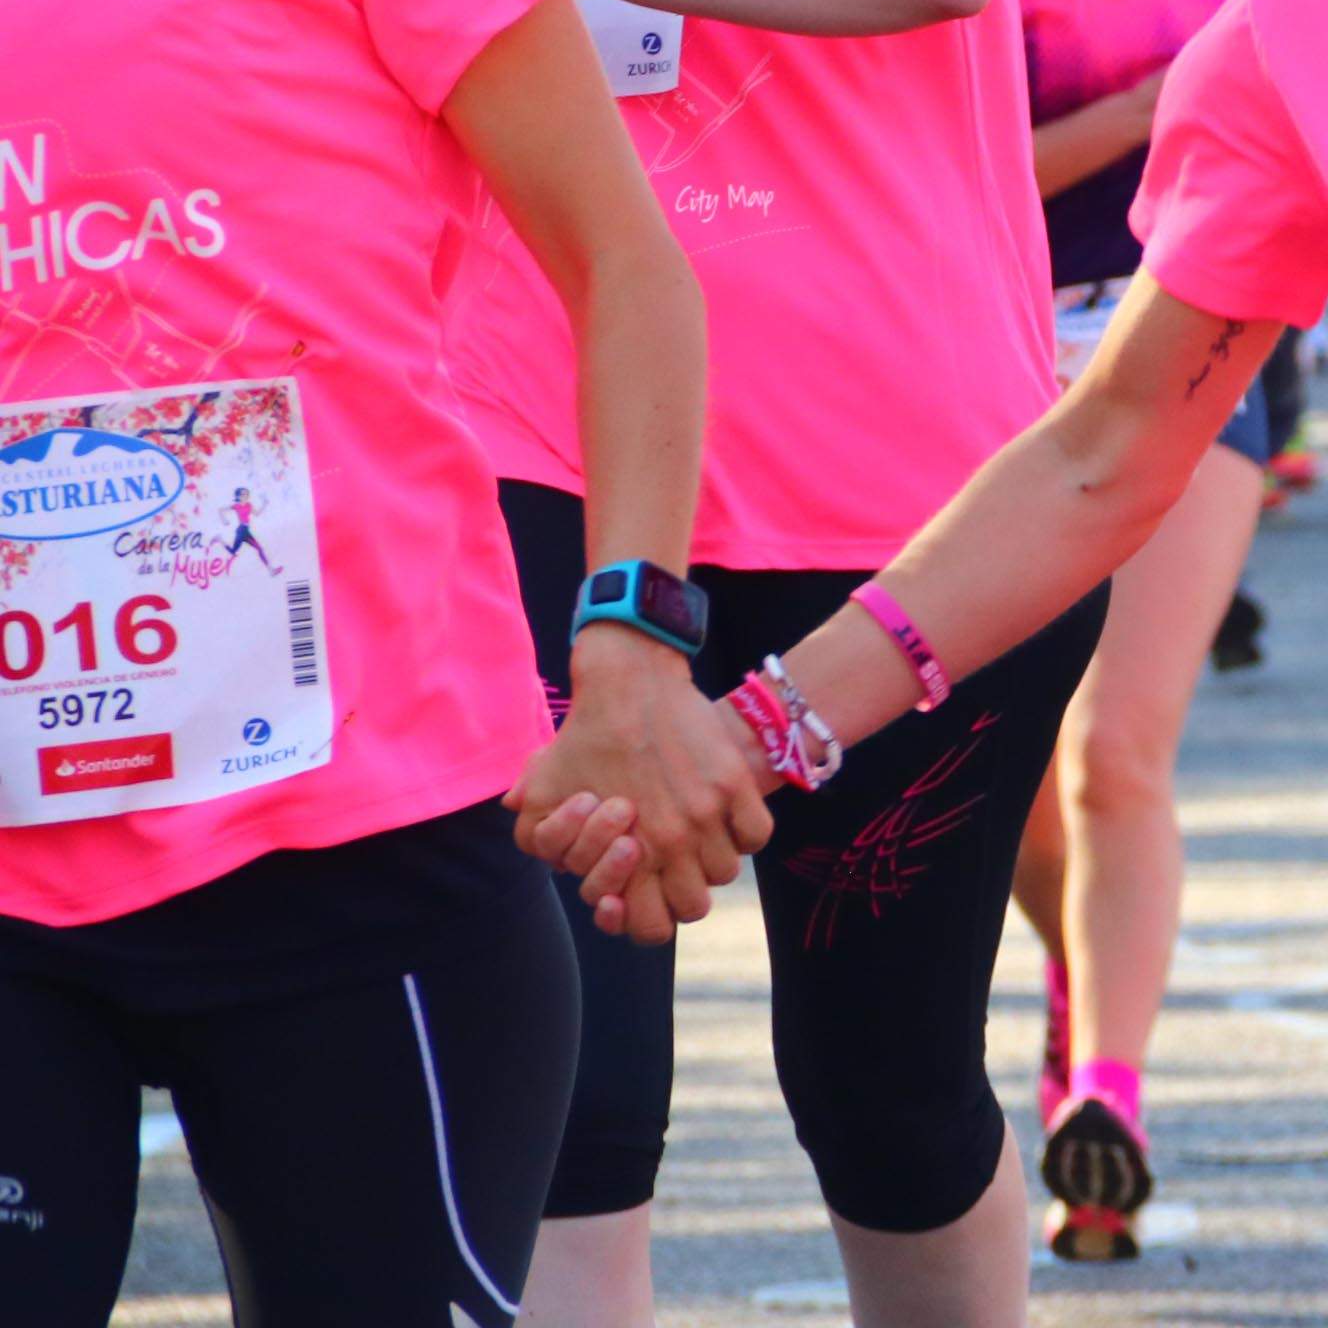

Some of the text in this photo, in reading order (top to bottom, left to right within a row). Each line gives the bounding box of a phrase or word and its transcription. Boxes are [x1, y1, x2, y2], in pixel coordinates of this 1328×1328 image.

[674, 185, 775, 223] City Map
[0, 472, 168, 518] STURIANA
[113, 531, 204, 559] Carrera
[138, 545, 238, 590] de la Mujer
[0, 593, 178, 681] 016
[38, 686, 137, 731] 5972
[76, 750, 157, 776] Santander
[220, 745, 299, 776] ZURICH
